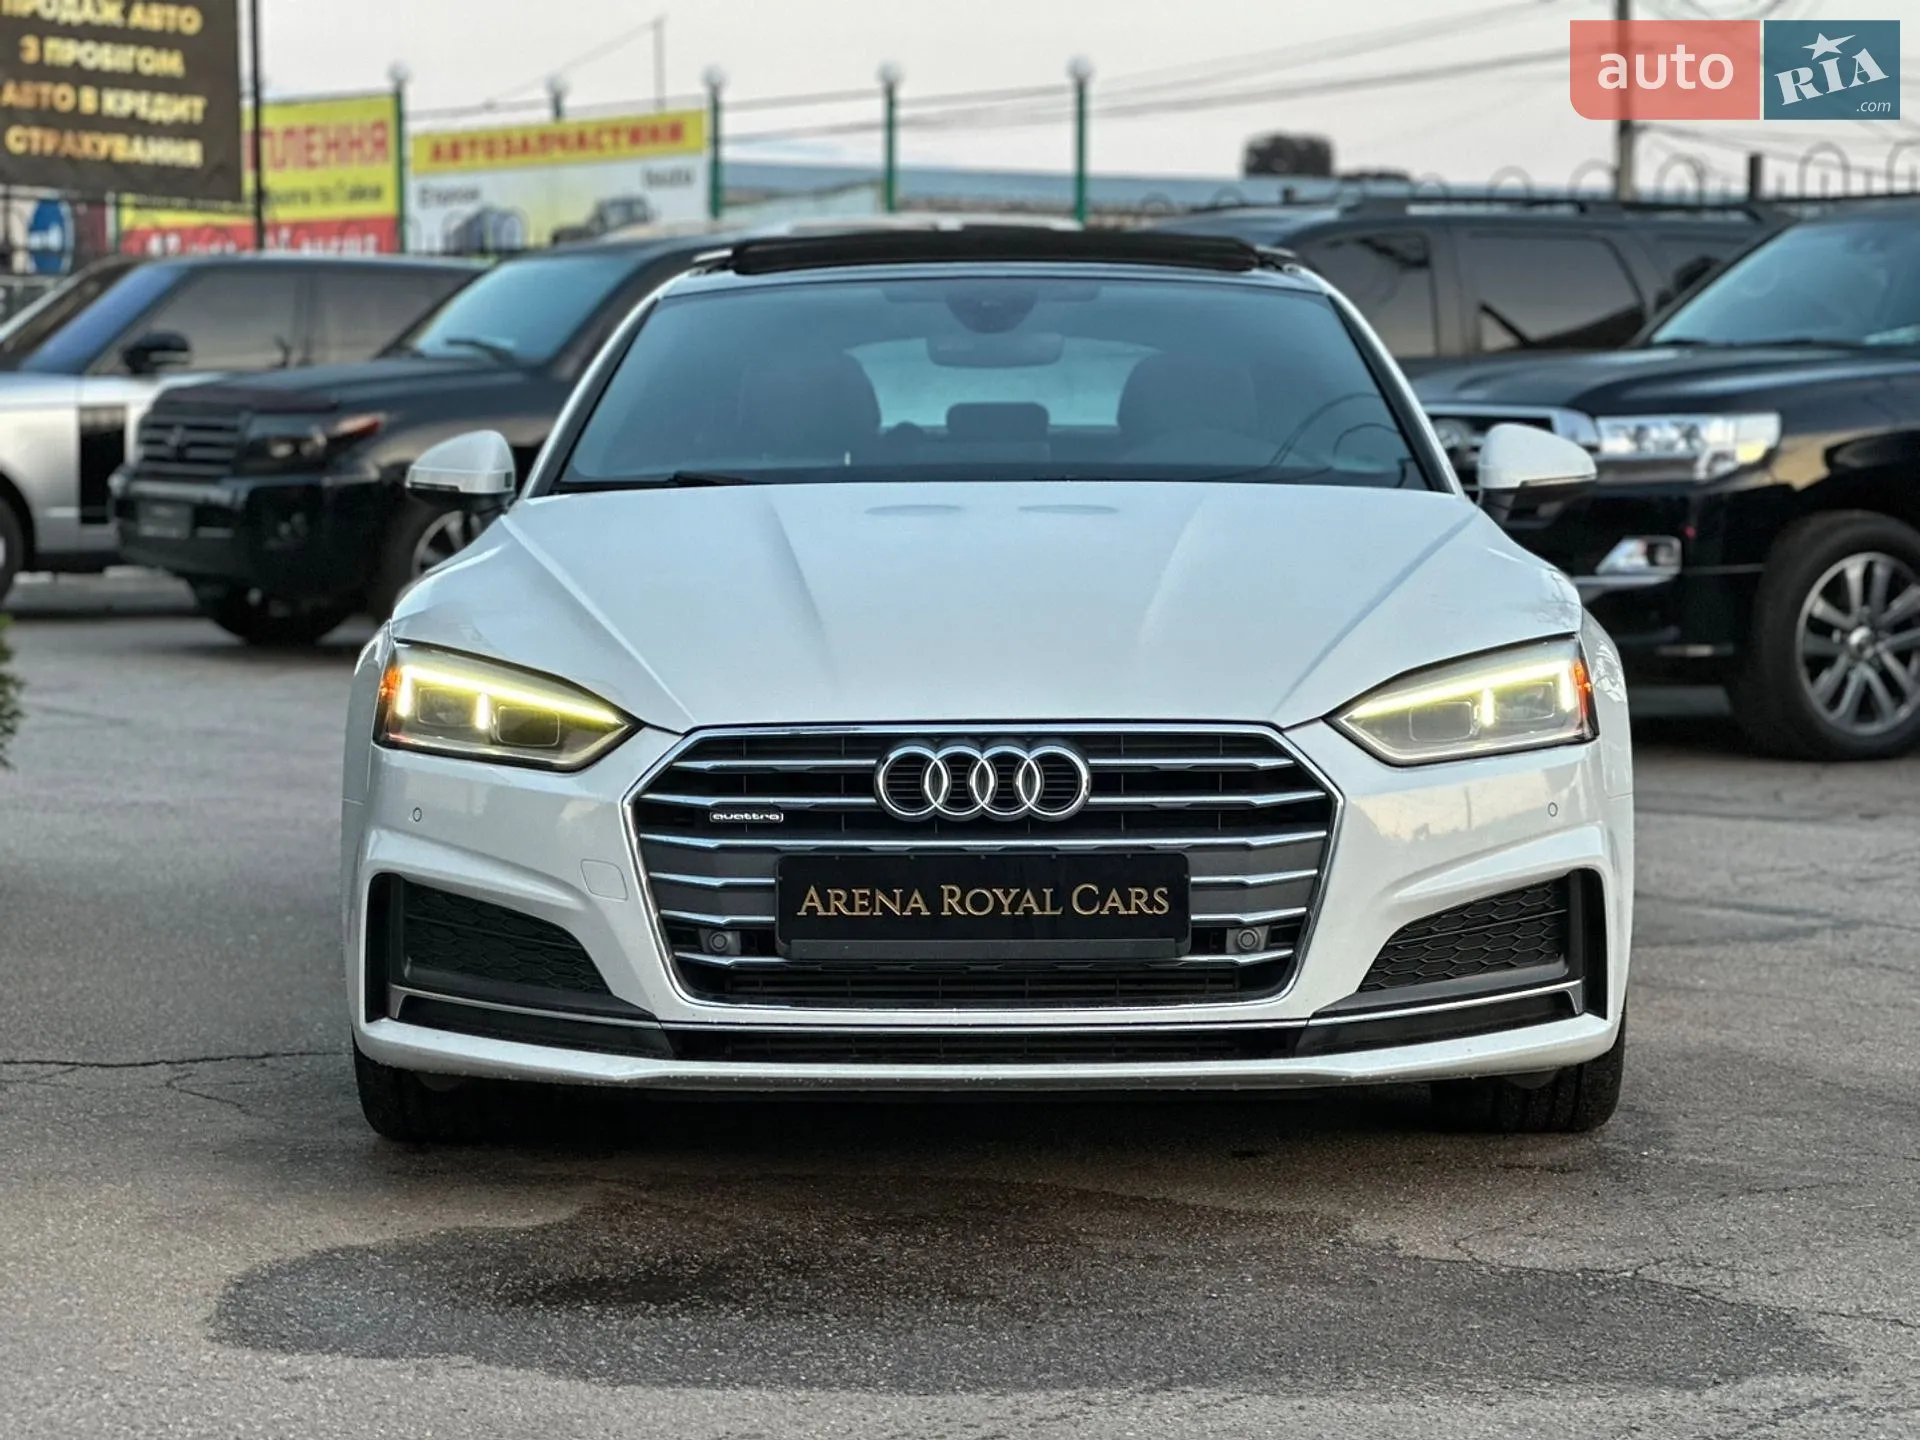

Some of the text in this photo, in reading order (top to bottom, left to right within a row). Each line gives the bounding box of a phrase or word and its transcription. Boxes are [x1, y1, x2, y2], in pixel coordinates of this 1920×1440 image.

[128, 3, 203, 35] АВТО
[1, 80, 206, 124] АВТО В КРЕДИТ
[5, 124, 203, 167] СТРАХУВАННЯ
[711, 812, 782, 821] quattro
[797, 883, 1170, 917] ARENA ROYAL CARS
